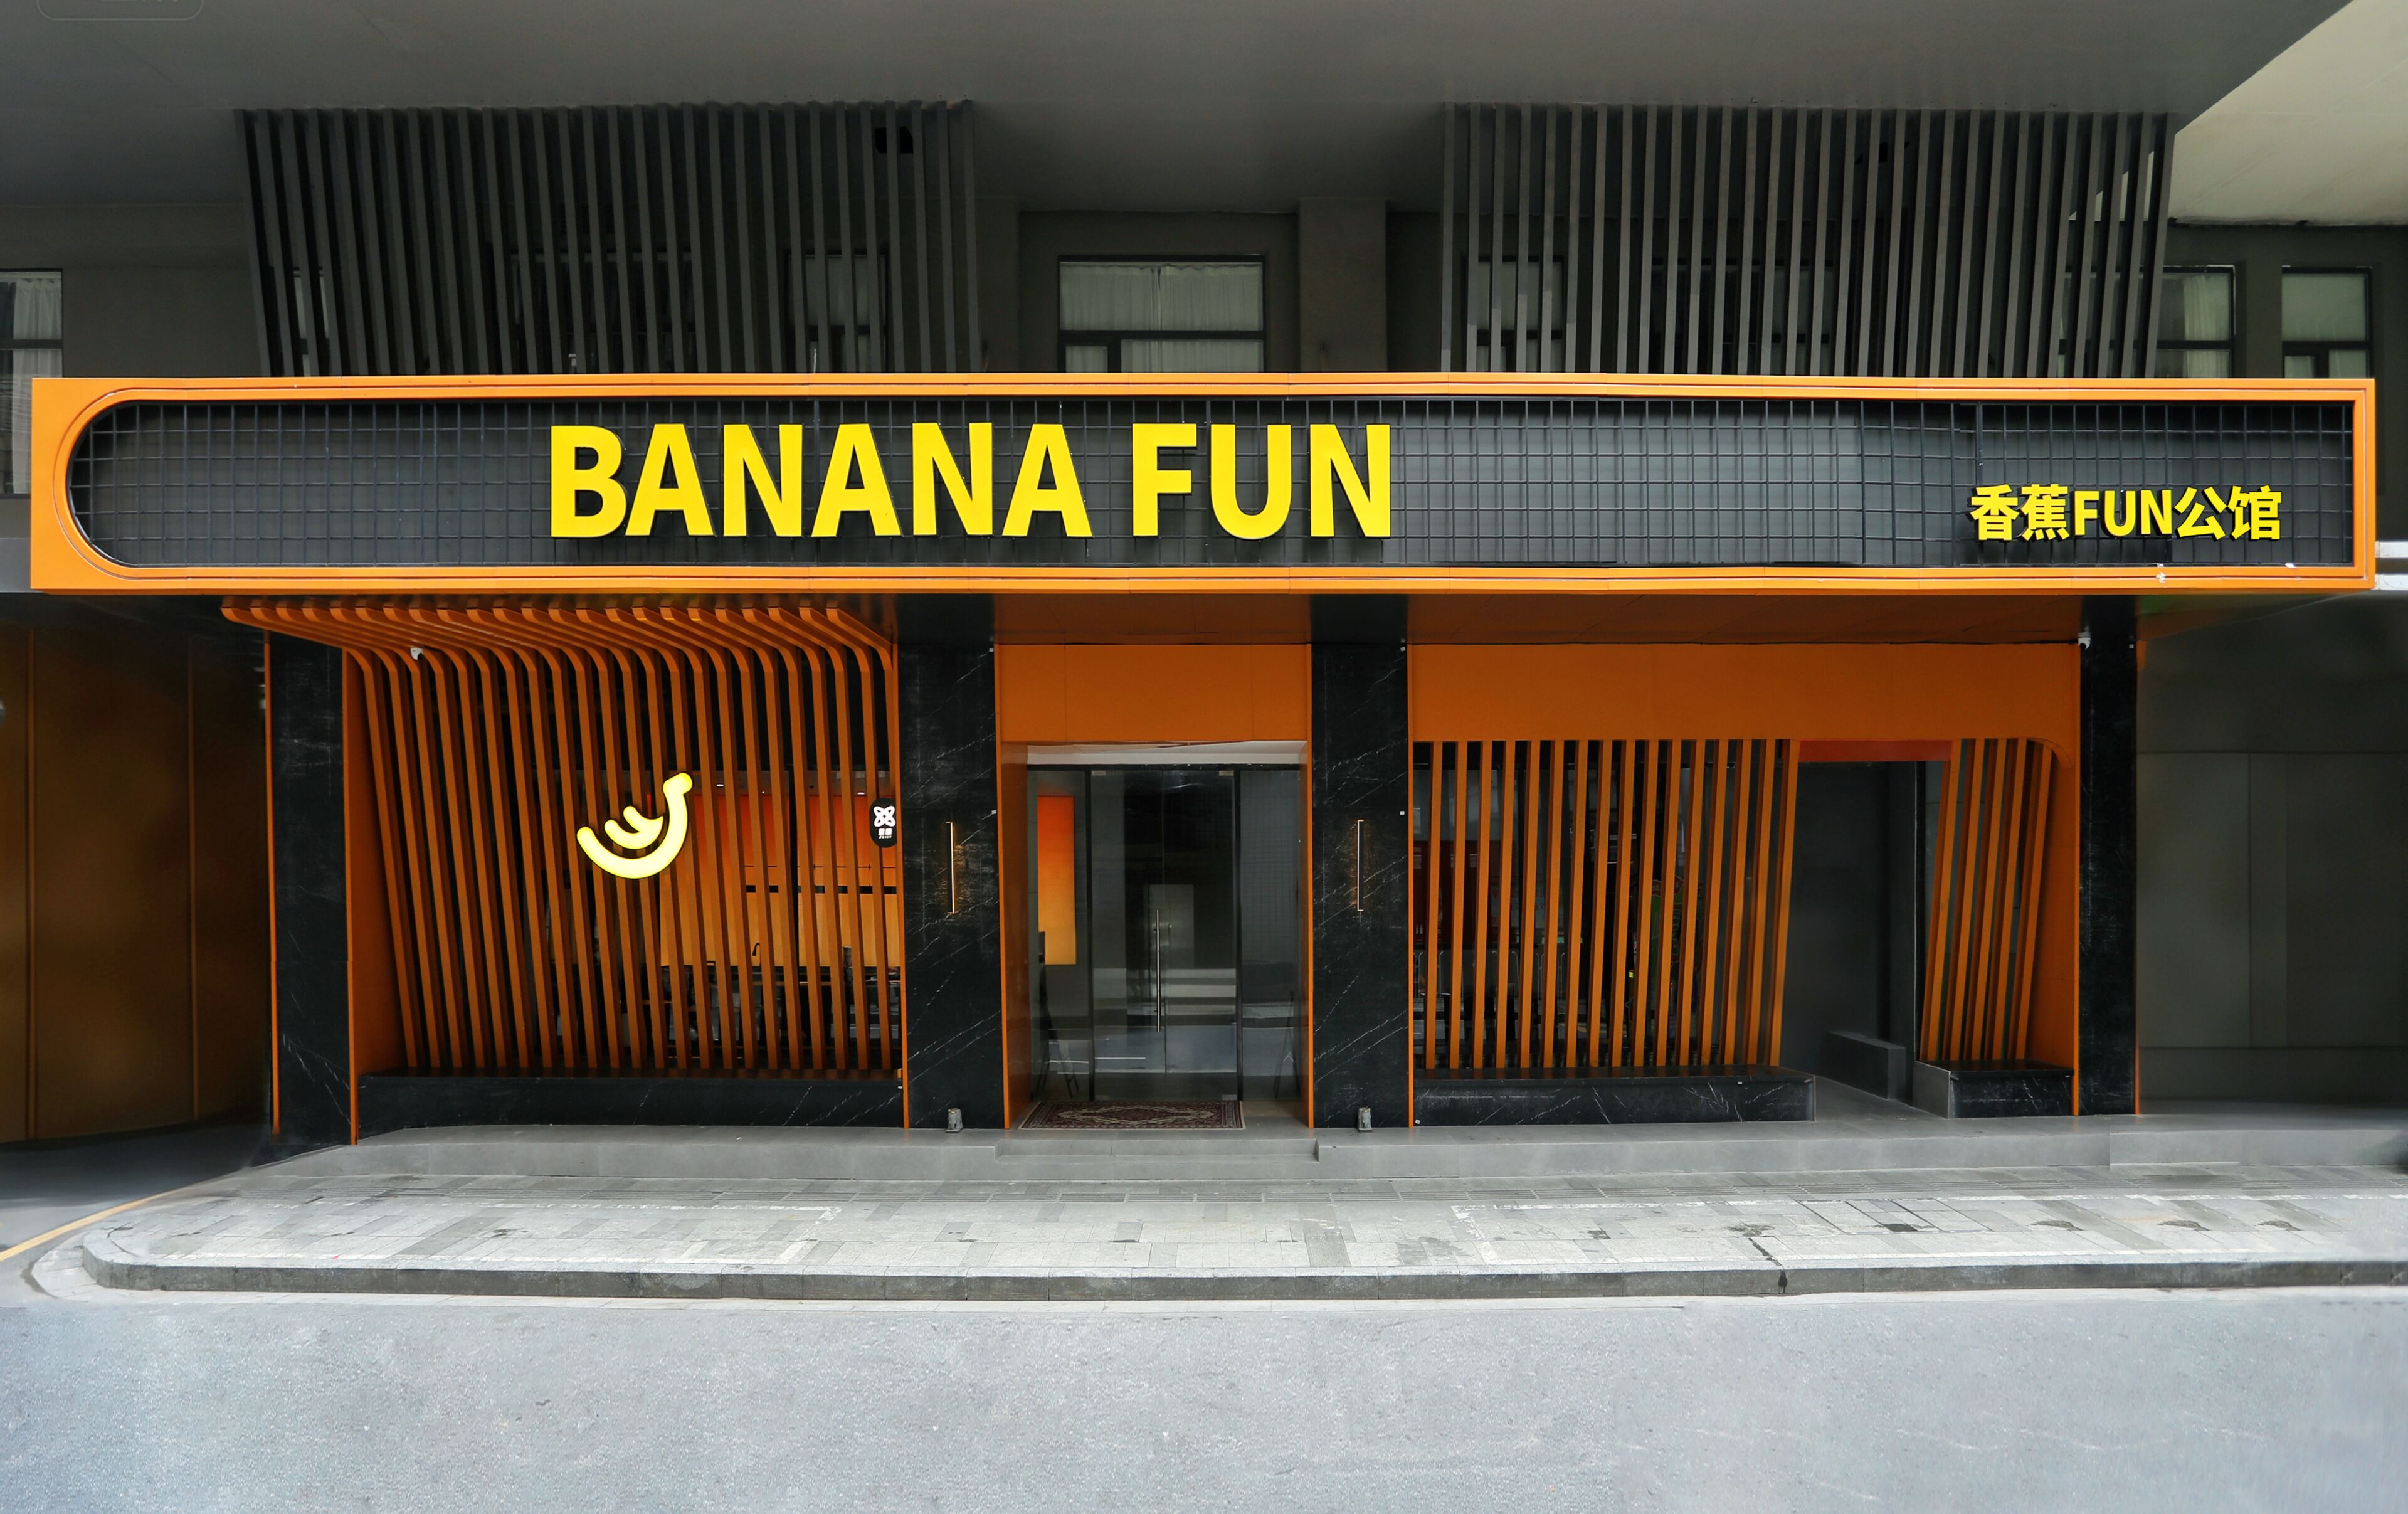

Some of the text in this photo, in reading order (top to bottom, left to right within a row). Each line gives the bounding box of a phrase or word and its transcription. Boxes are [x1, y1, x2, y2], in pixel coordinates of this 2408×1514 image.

[551, 422, 1391, 539] BANANA FUN
[1970, 484, 2282, 541] 香蕉FUN公馆
